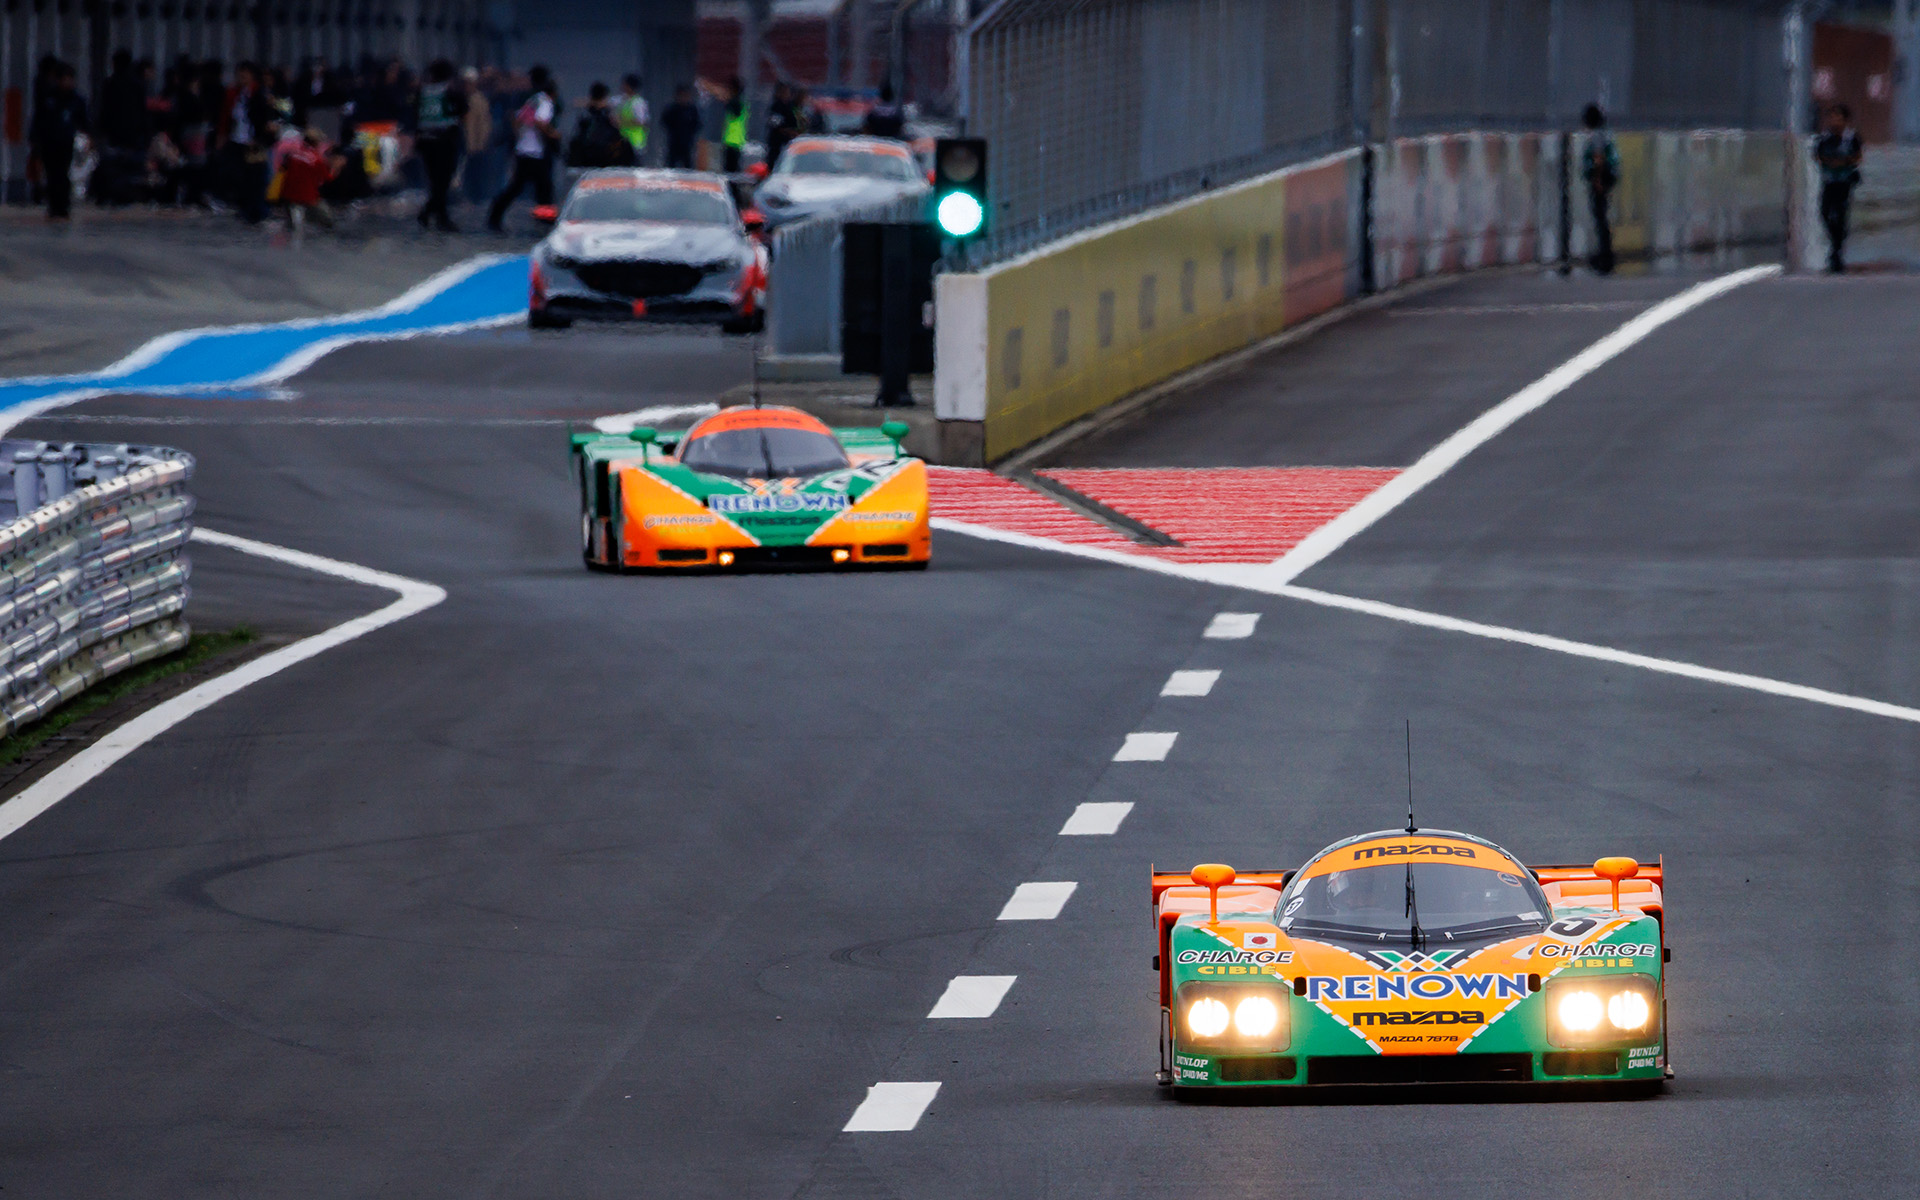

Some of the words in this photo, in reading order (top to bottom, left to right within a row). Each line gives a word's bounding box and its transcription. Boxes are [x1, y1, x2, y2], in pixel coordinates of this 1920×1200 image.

[709, 494, 847, 512] RENOWN
[1354, 845, 1476, 860] mazda
[1178, 950, 1295, 964] CHARGE
[1540, 943, 1656, 958] CHARGE
[1307, 973, 1530, 1001] RENOWN
[1353, 1011, 1484, 1025] mazda
[1628, 1046, 1660, 1057] DUNLOP
[1177, 1056, 1208, 1068] DUNLOP
